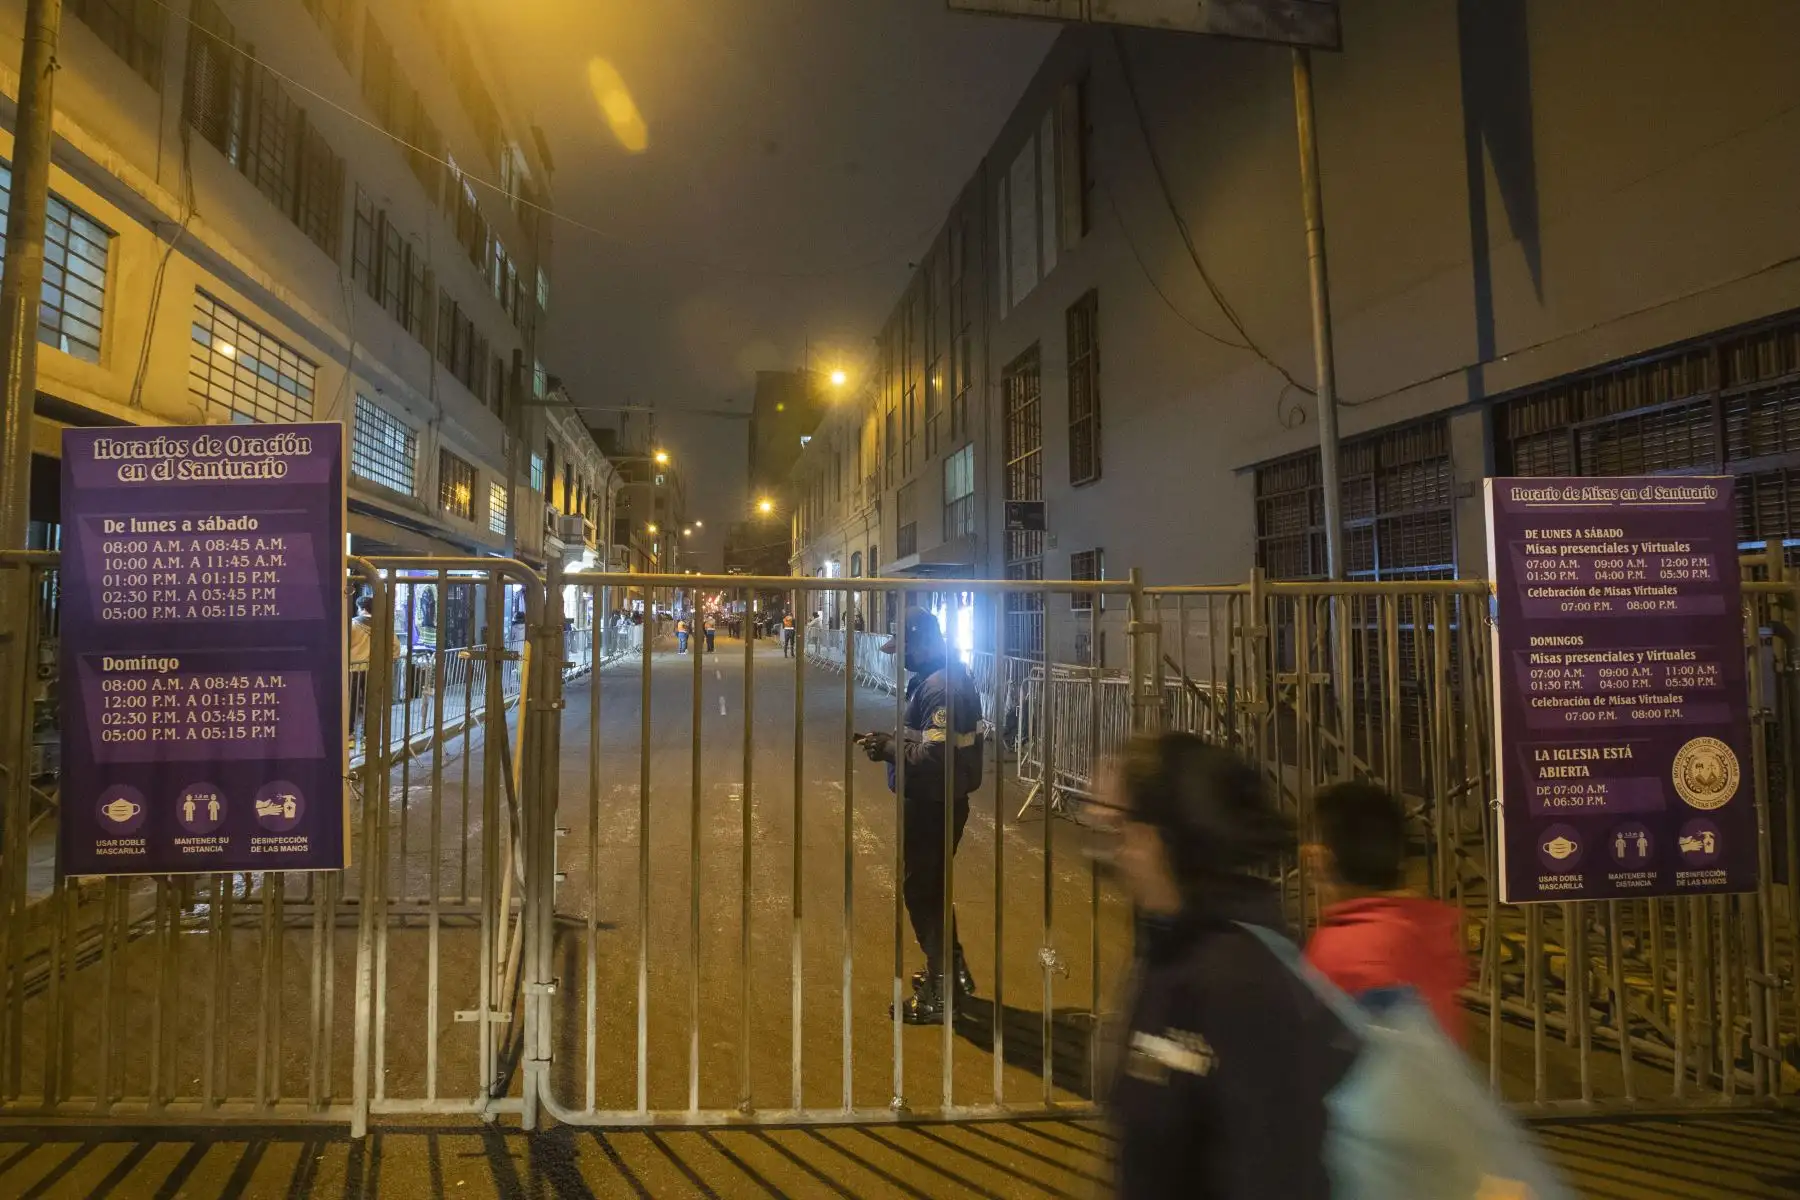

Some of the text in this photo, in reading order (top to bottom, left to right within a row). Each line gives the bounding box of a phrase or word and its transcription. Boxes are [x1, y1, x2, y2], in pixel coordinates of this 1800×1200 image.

[94, 433, 312, 459] Horarios de Oración
[118, 458, 287, 482] en el Santuario
[1511, 485, 1717, 500] Horario de Misas en el Santuario
[104, 516, 258, 534] De lunes a sábado
[1525, 526, 1623, 538] DE LUNES A SÁBADO
[103, 538, 287, 553] 08:00 A.M. A 08:45 A.M.
[1526, 541, 1690, 557] Misas presenciales y Virtuales
[105, 554, 287, 569] 10:00 A.M. A 11:45 A.M.
[1526, 558, 1710, 568] 07:00 A.M. 09:00 A.M. 12:00 P.M.
[103, 571, 280, 586] 01:00 P.M. A 01:15 P.M.
[1526, 569, 1711, 580] 01:30 P.M. 04:00 P.M. 05:30 P.M.
[103, 588, 276, 603] 02:30 P.M. A 03:45 P.M
[1528, 585, 1678, 597] Celebración de Misas Virtuales
[103, 604, 280, 619] 05:00 P.M. A 05:15 P.M.
[1561, 600, 1678, 611] 07:00 P.M. 08:00 P.M.
[1530, 636, 1584, 646] DOMINGOS
[102, 655, 179, 673] Domingo
[1530, 650, 1696, 666] Misas presenciales y Virtuales
[1531, 666, 1717, 678] 07:00 A.M. 09:00 A.M. 11:00 A.M.
[102, 675, 286, 691] 08:00 A.M. A 08:45 A.M.
[1531, 678, 1716, 690] 01:30 P.M. 04:00 P.M. 05:30 P.M.
[104, 692, 280, 708] 12:00 P.M. A 01:15 P.M.
[1532, 694, 1683, 708] Celebración de Misas Virtuales
[102, 709, 280, 724] 02:30 P.M. A 03:45 P.M.
[1565, 709, 1683, 721] 07:00 P.M. 08:00 P.M.
[102, 726, 276, 741] 05:00 P.M. A 05:15 P.M
[1535, 744, 1633, 761] LA IGLESIA ESTÁ
[1539, 766, 1590, 778] ABIERTA
[1536, 784, 1608, 796] DE 07:00 A.M.
[1543, 796, 1606, 806] A 06:30 P.M.
[174, 837, 216, 845] MANTENER
[280, 844, 308, 852] MANOS
[96, 847, 146, 855] MASCARILLA
[183, 845, 223, 853] DISTANCIA
